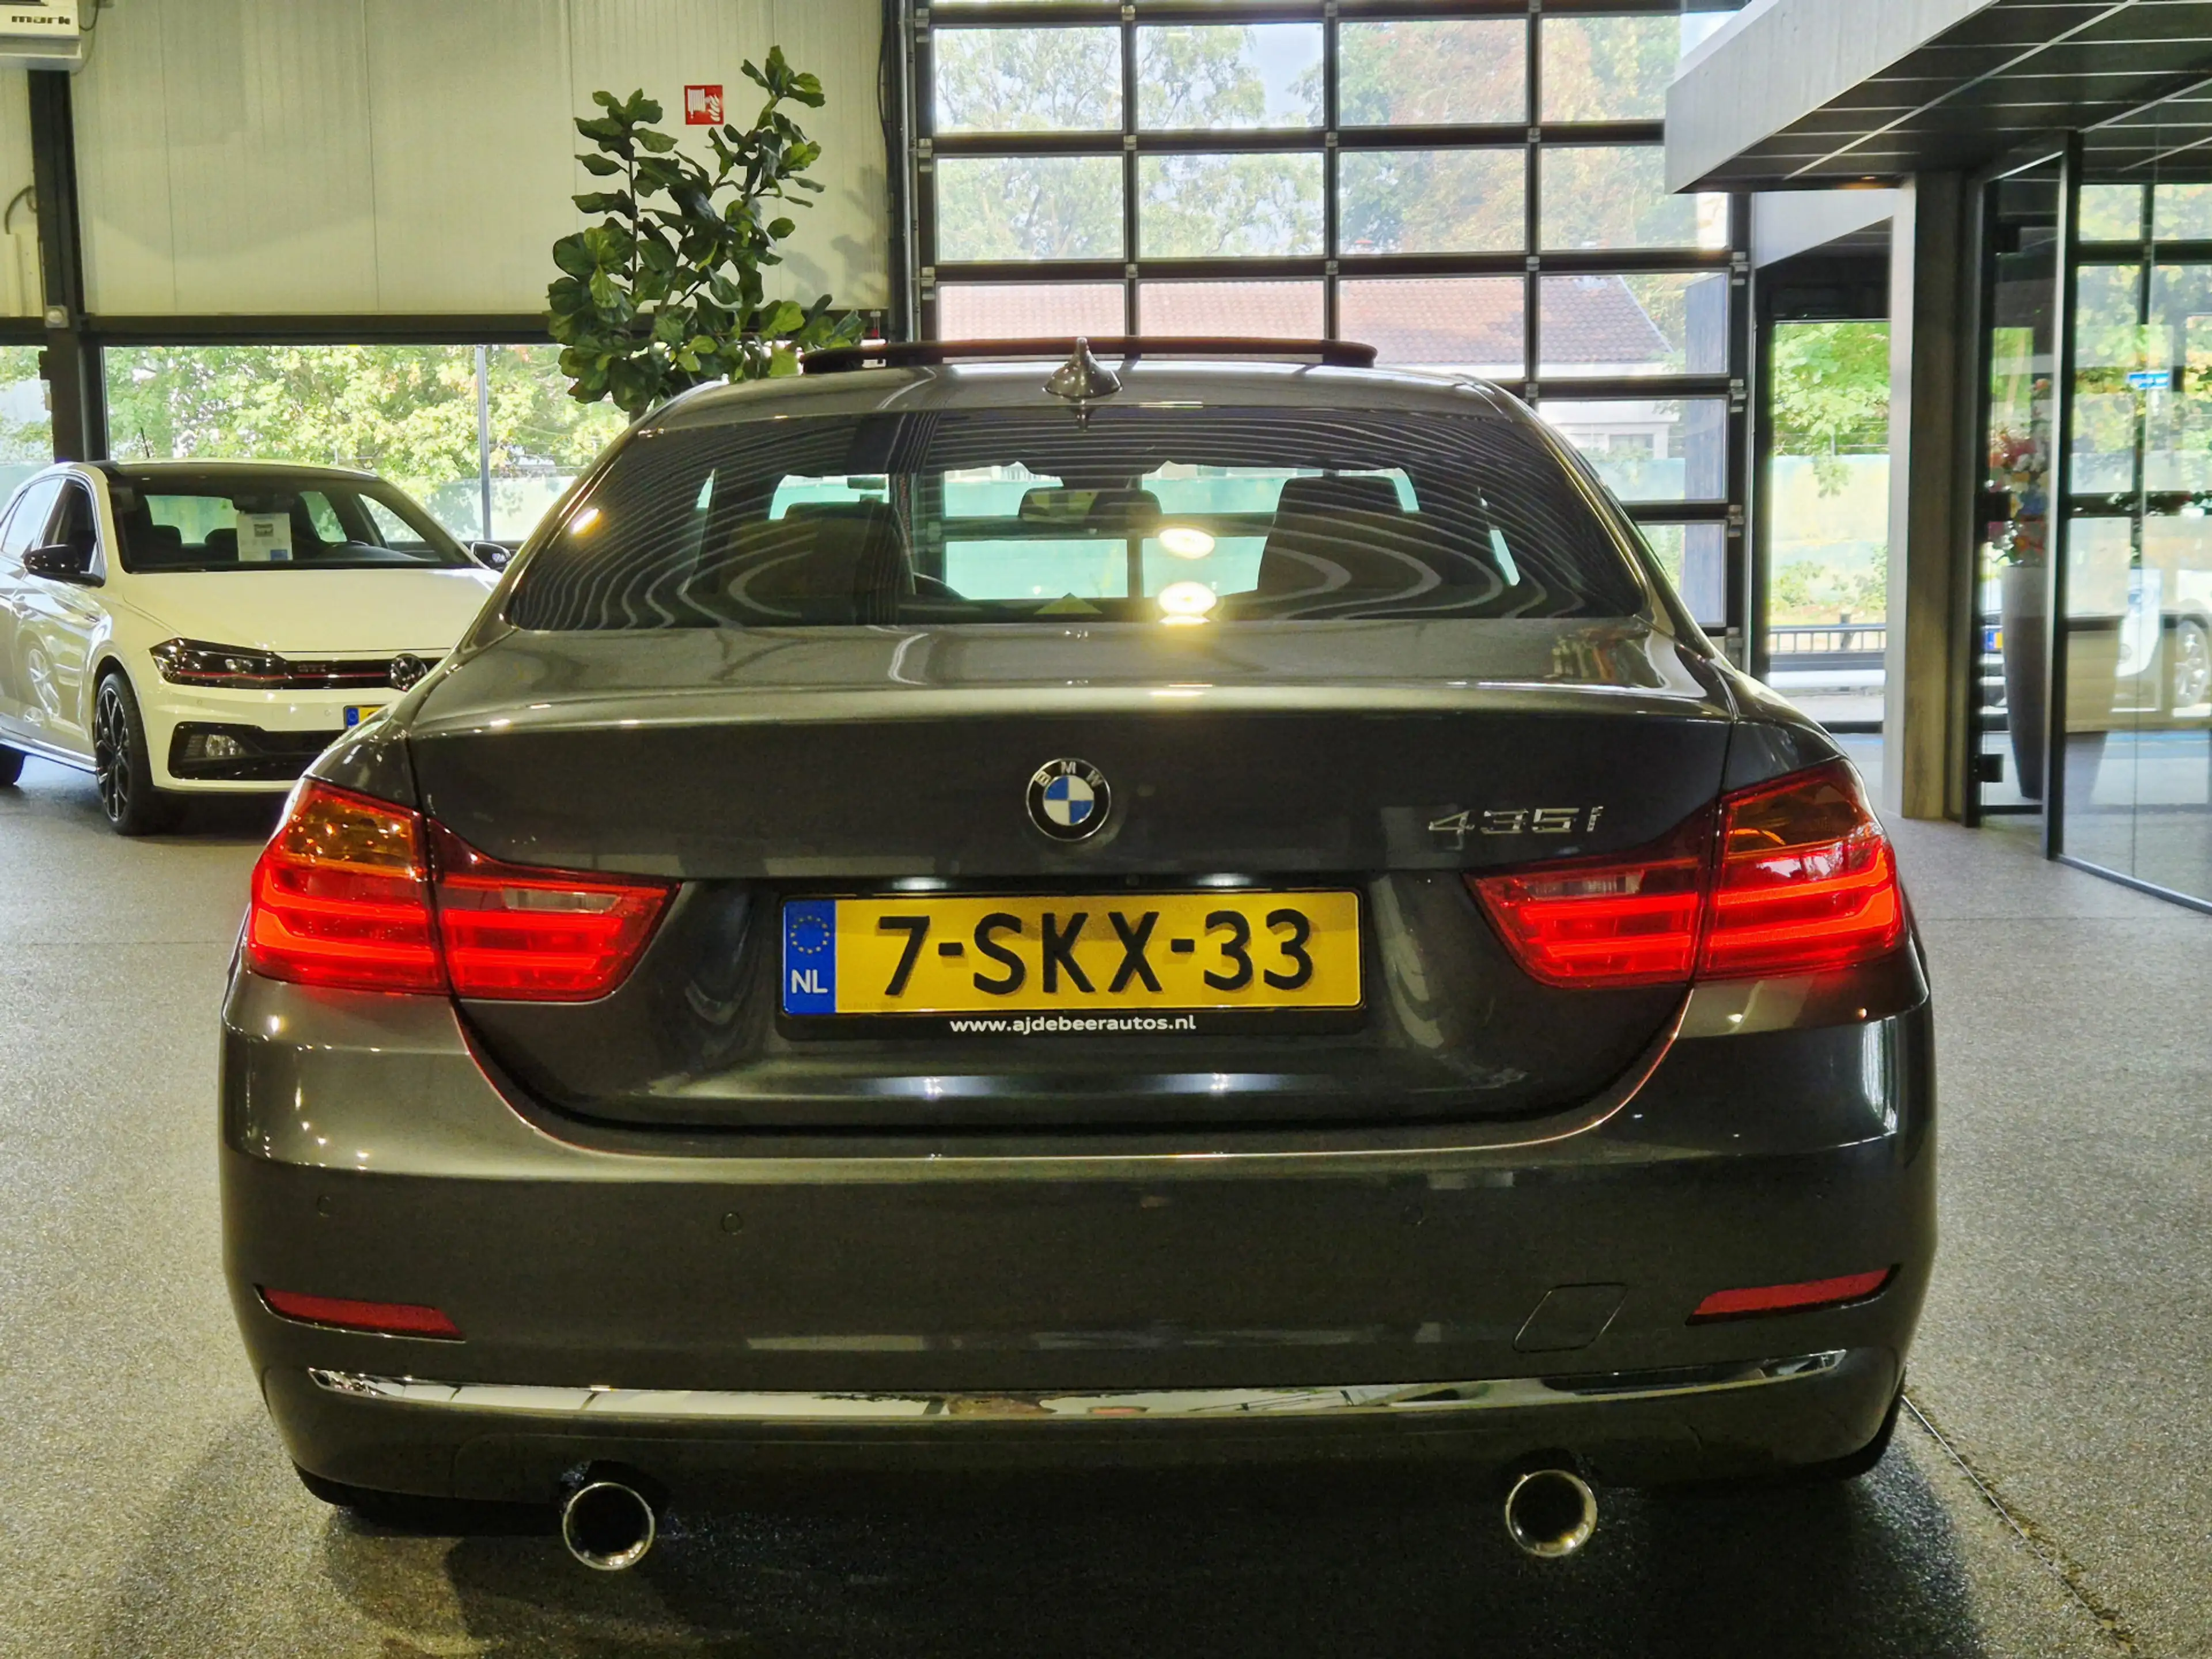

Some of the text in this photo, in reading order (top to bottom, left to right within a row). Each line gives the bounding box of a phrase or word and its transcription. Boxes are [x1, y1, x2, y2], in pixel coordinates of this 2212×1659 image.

[12, 16, 70, 24] mark
[1034, 761, 1104, 787] BMW
[1428, 806, 1604, 834] 435i
[878, 908, 1313, 996] 7-SKX-33
[790, 969, 828, 994] NL
[949, 1015, 1196, 1035] www.ajdebeerautos.nl
